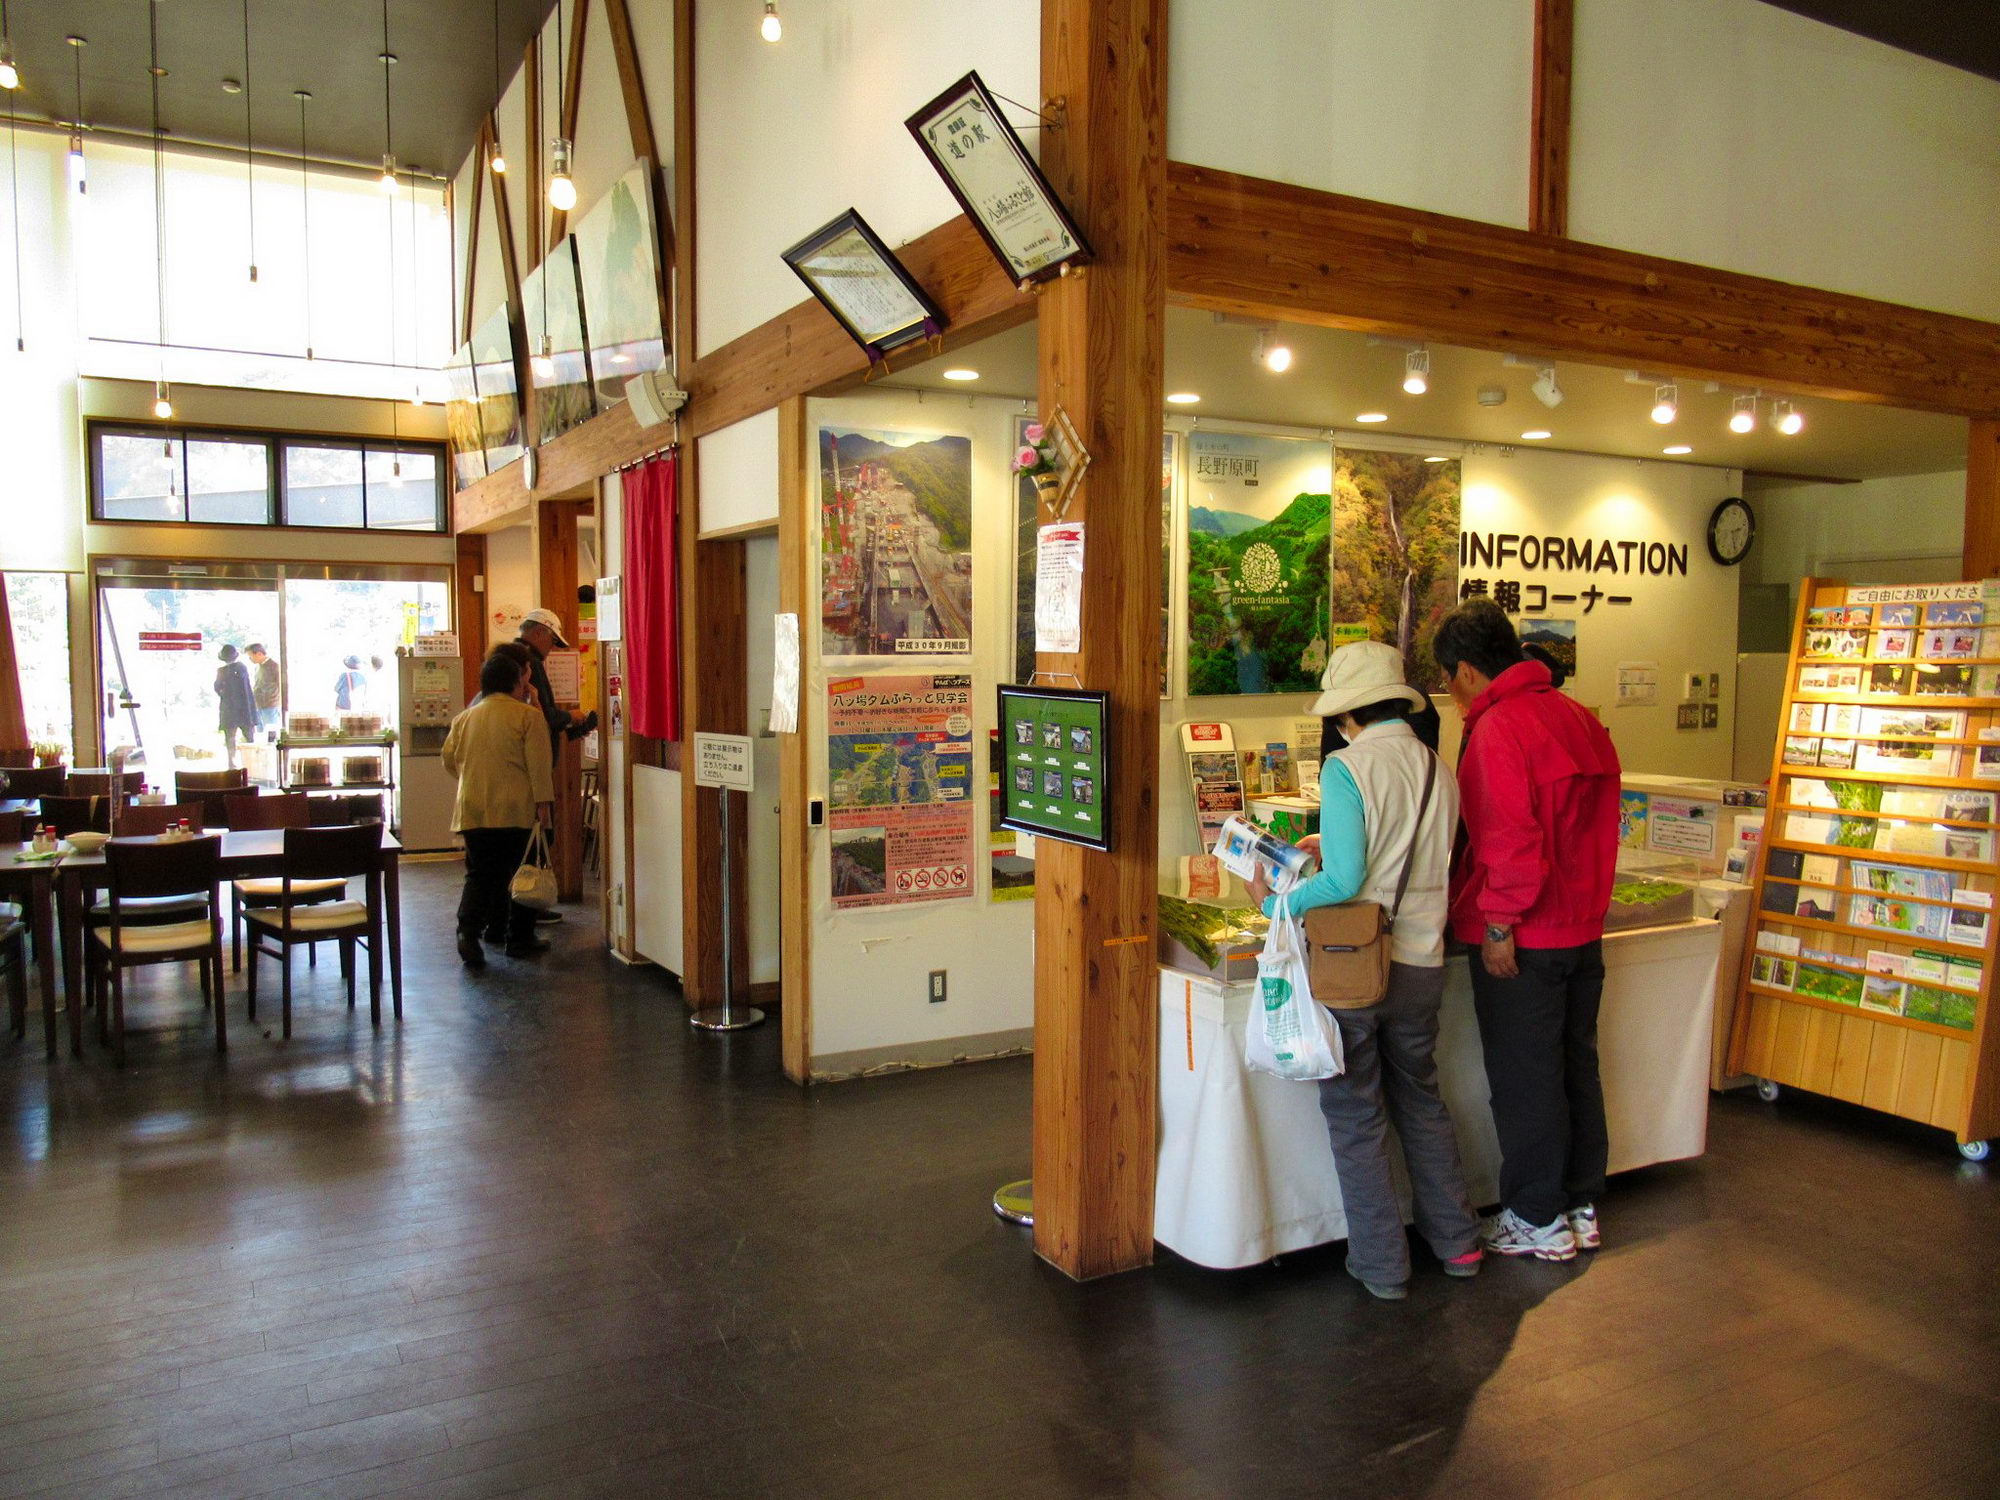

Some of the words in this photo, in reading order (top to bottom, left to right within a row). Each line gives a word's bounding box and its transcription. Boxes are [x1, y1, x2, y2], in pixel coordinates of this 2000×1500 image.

[1197, 456, 1260, 478] 長野原町
[1460, 531, 1689, 576] INFORMATION
[1232, 595, 1290, 606] green-fantasia
